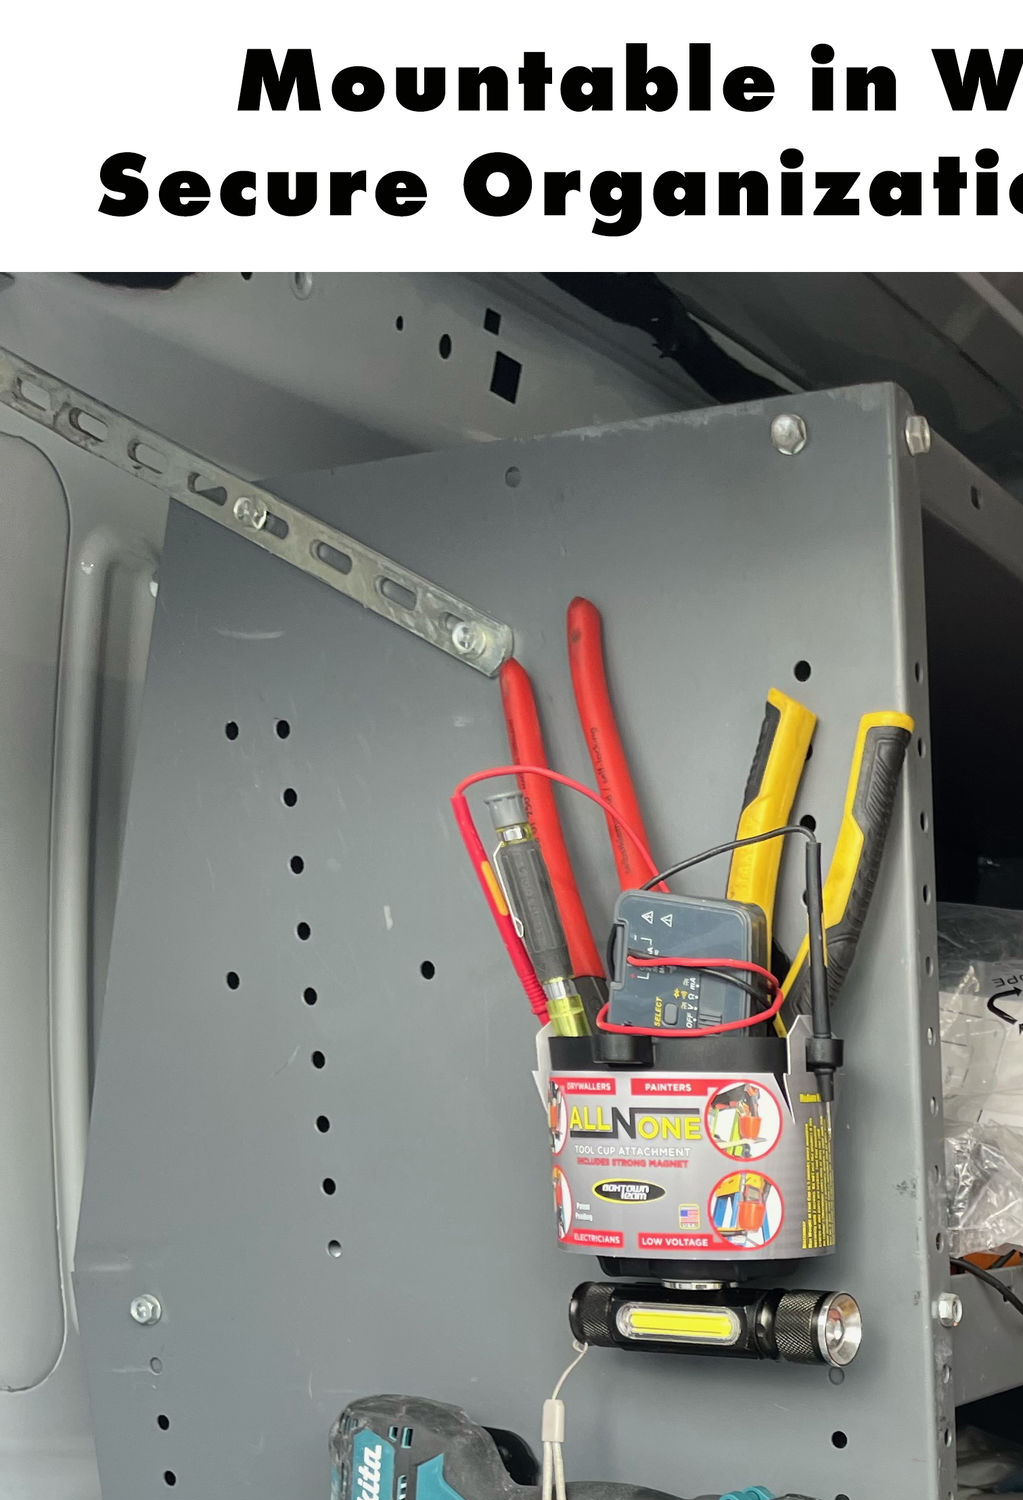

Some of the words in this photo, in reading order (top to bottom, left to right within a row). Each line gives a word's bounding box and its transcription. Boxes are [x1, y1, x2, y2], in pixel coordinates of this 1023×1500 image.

[653, 996, 663, 1027] SELECT
[644, 1083, 692, 1092] PAINTERS
[574, 1145, 594, 1155] TOOL
[598, 1146, 615, 1155] CUP
[618, 1147, 691, 1157] ATTACHMENT
[612, 1158, 646, 1167] STRONG
[648, 1159, 689, 1169] MAGNET
[573, 1233, 621, 1244] ELECTRICIANS
[641, 1237, 663, 1246] LOW
[665, 1238, 709, 1247] VOLTAGE
